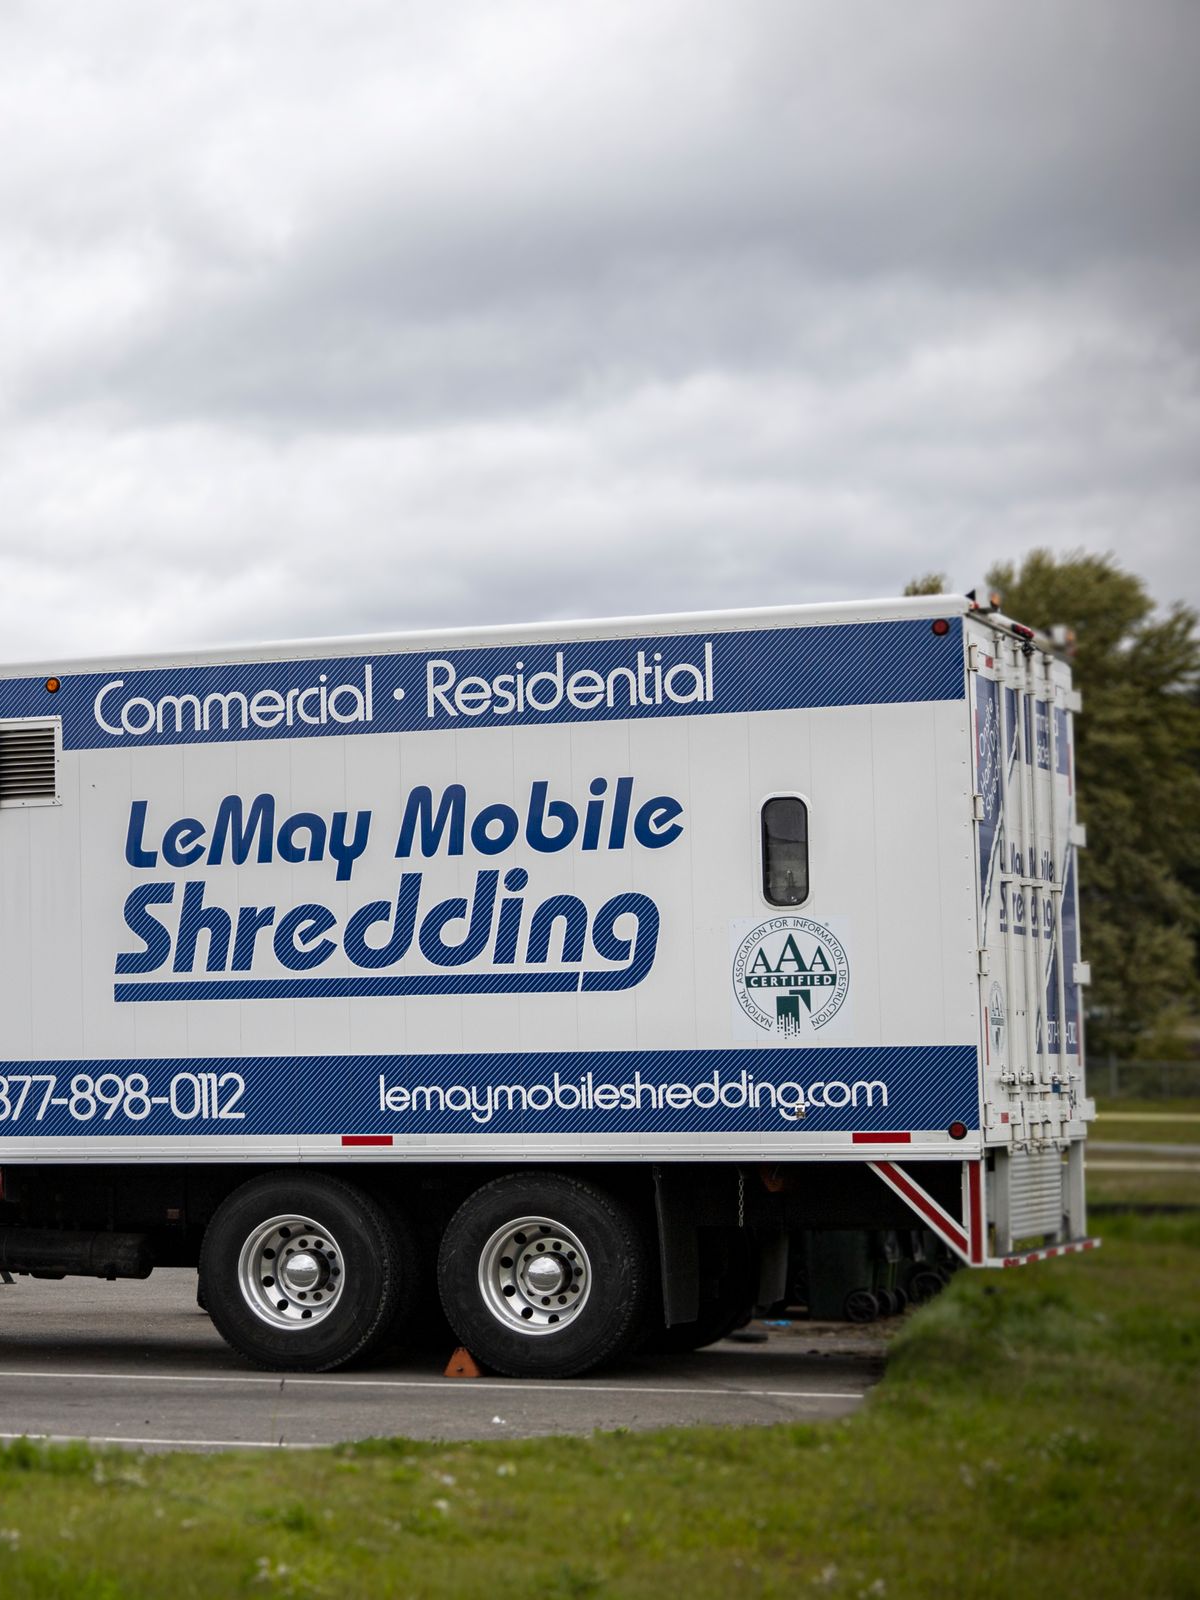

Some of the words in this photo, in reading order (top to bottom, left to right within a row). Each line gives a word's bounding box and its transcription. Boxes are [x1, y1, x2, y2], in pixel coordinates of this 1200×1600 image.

[94, 664, 373, 736] Commercial
[426, 642, 715, 718] Residential
[124, 792, 372, 881] LeMay
[394, 776, 686, 858] Mobile
[114, 867, 660, 1002] Shredding
[769, 919, 789, 930] FOR
[793, 919, 845, 965] INFORMATION
[736, 926, 767, 984] ASSOCIATION
[749, 933, 833, 974] AAA
[738, 988, 774, 1028] NATIONAL
[750, 975, 833, 987] CERTIFIED
[810, 969, 847, 1028] DESTRUCTION
[379, 1070, 888, 1124] lemaymobileshredding.com
